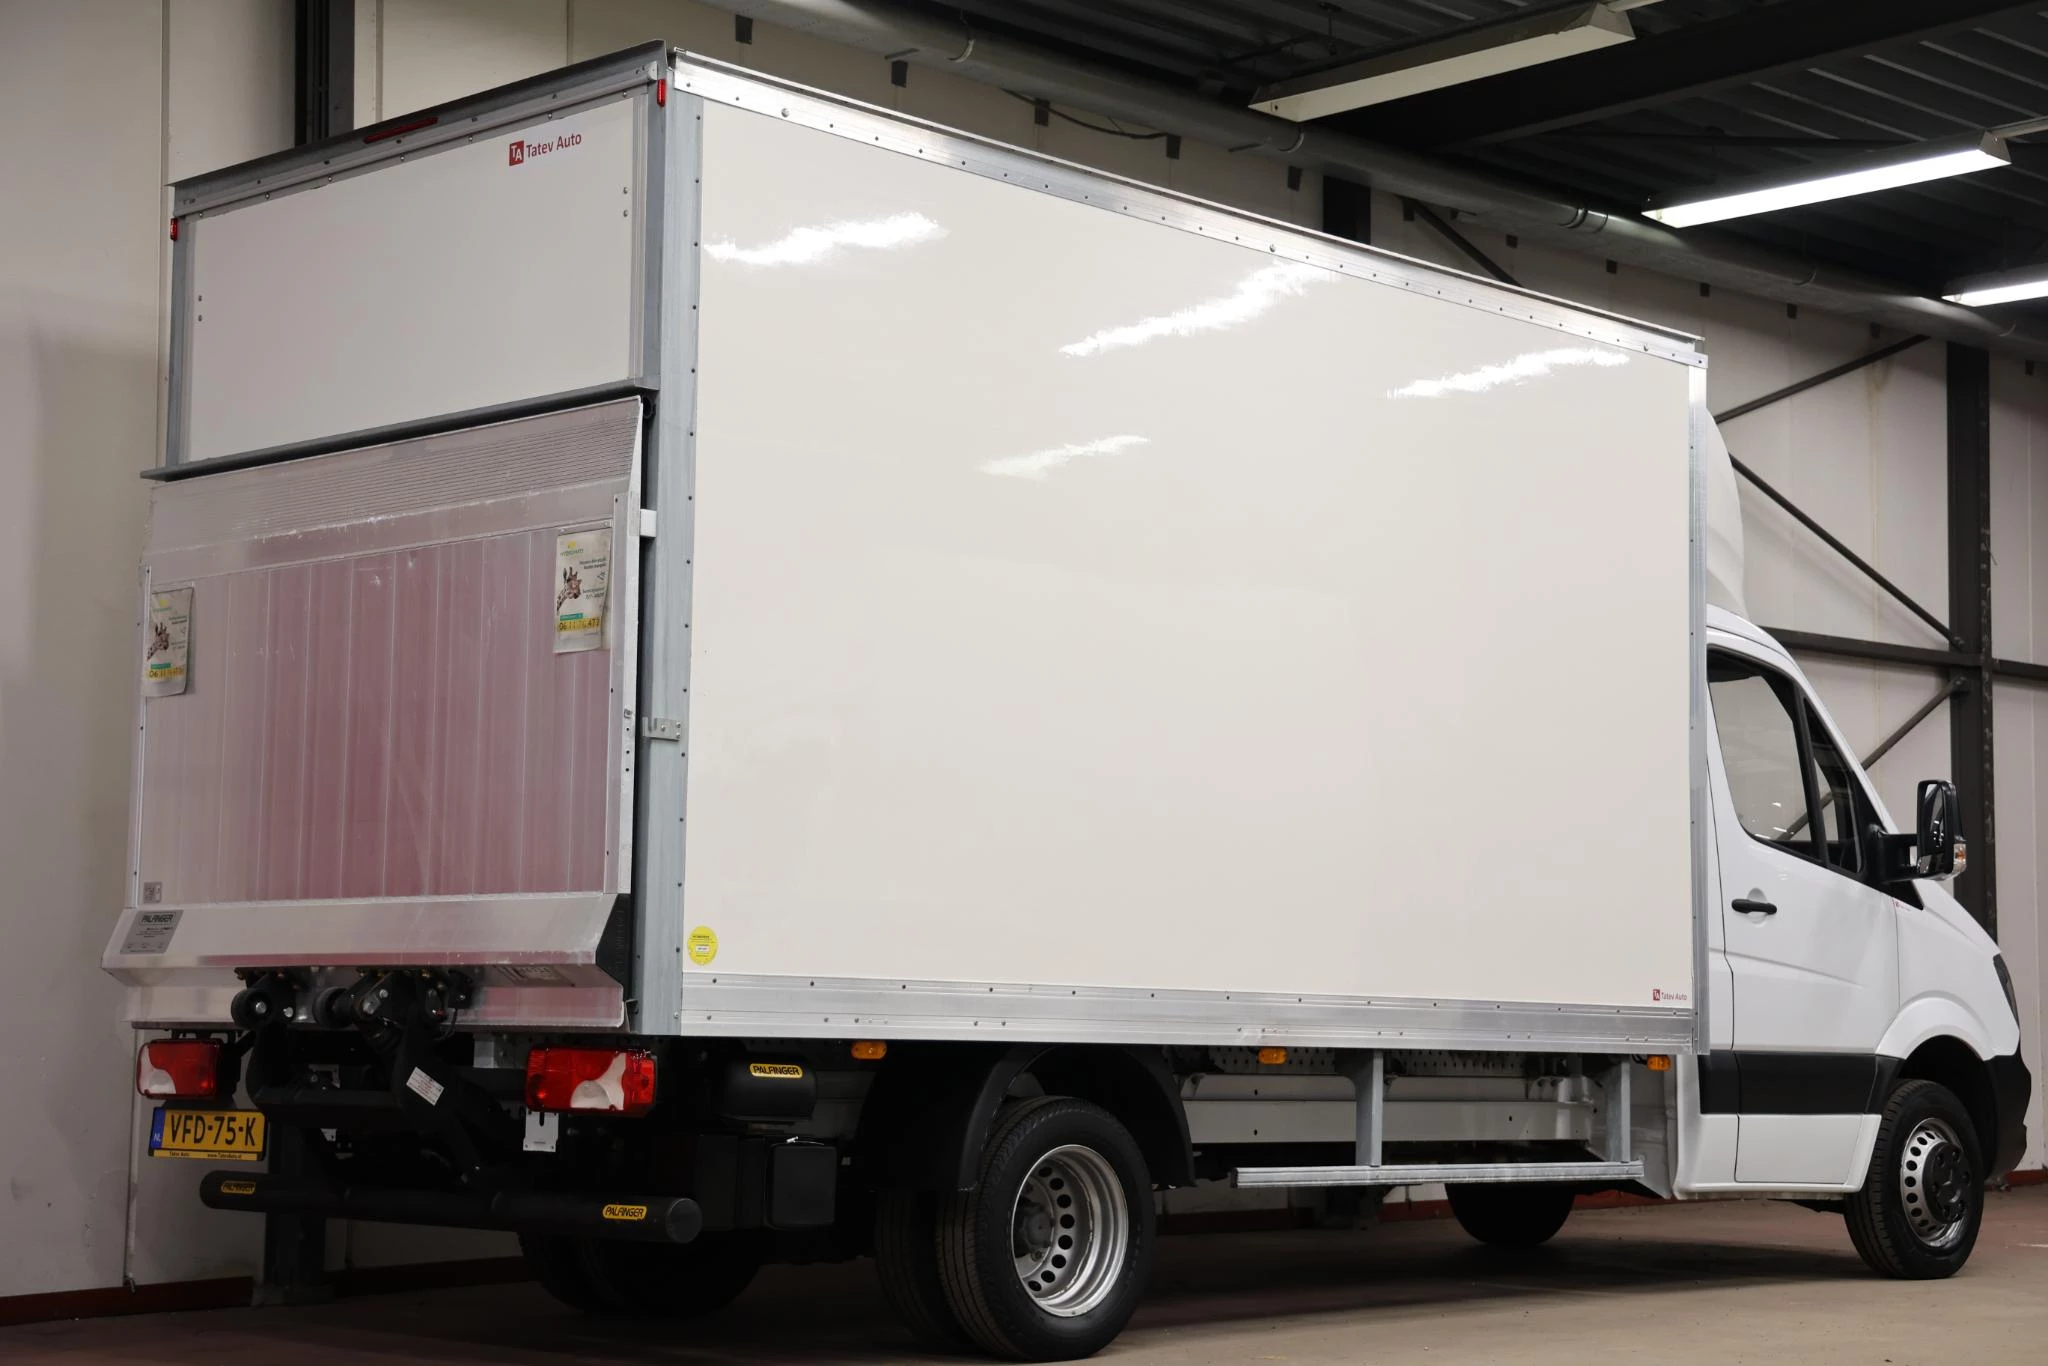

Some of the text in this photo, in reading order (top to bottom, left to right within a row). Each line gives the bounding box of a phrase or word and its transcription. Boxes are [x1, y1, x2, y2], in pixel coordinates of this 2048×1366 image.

[510, 133, 582, 162] TA Tatev Auto
[1661, 992, 1674, 1000] Tatev
[753, 1065, 800, 1075] PALFINGER
[171, 1114, 256, 1146] VFD-75-K
[605, 1206, 644, 1217] PALFINGER
